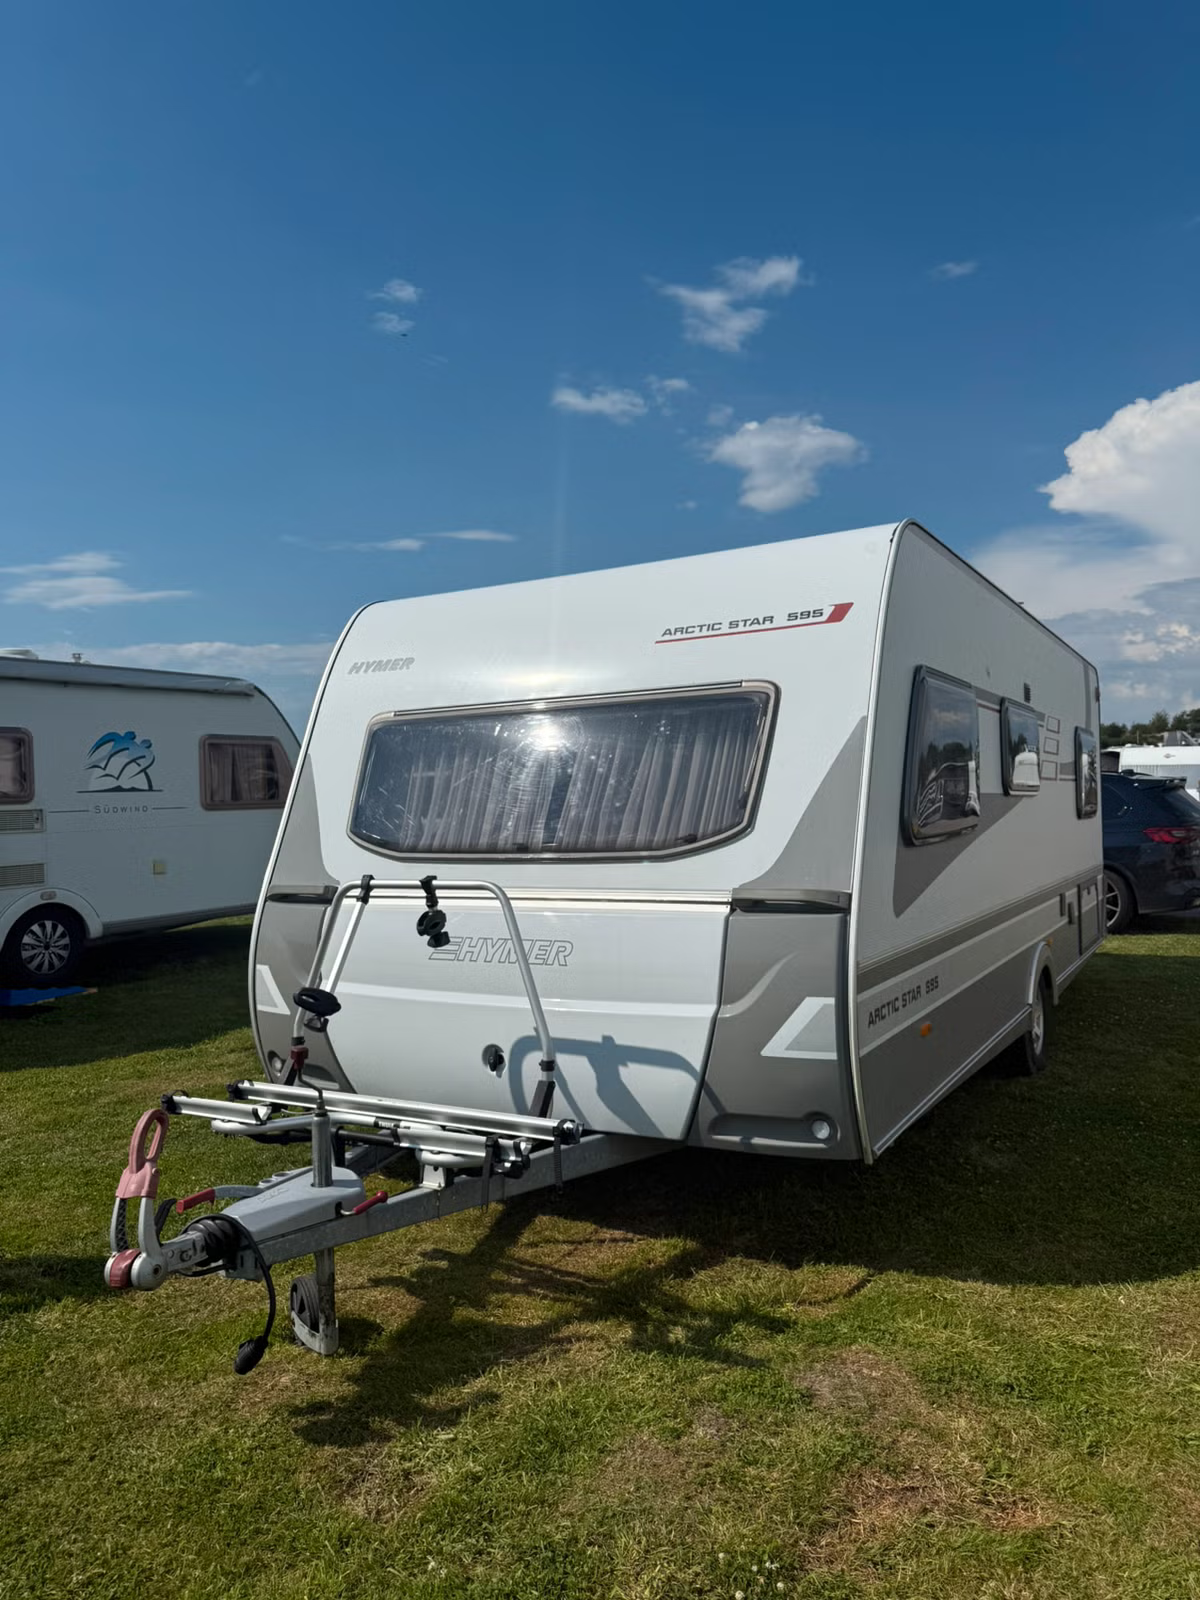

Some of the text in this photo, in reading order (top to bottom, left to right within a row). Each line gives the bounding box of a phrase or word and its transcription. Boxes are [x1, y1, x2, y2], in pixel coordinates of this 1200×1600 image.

[661, 608, 824, 637] ARCTIC STAR 595
[347, 657, 416, 675] HYMER
[94, 804, 149, 814] SÜDWIND
[456, 936, 574, 967] HYMER
[867, 975, 939, 1029] ARCTIC STAR 595
